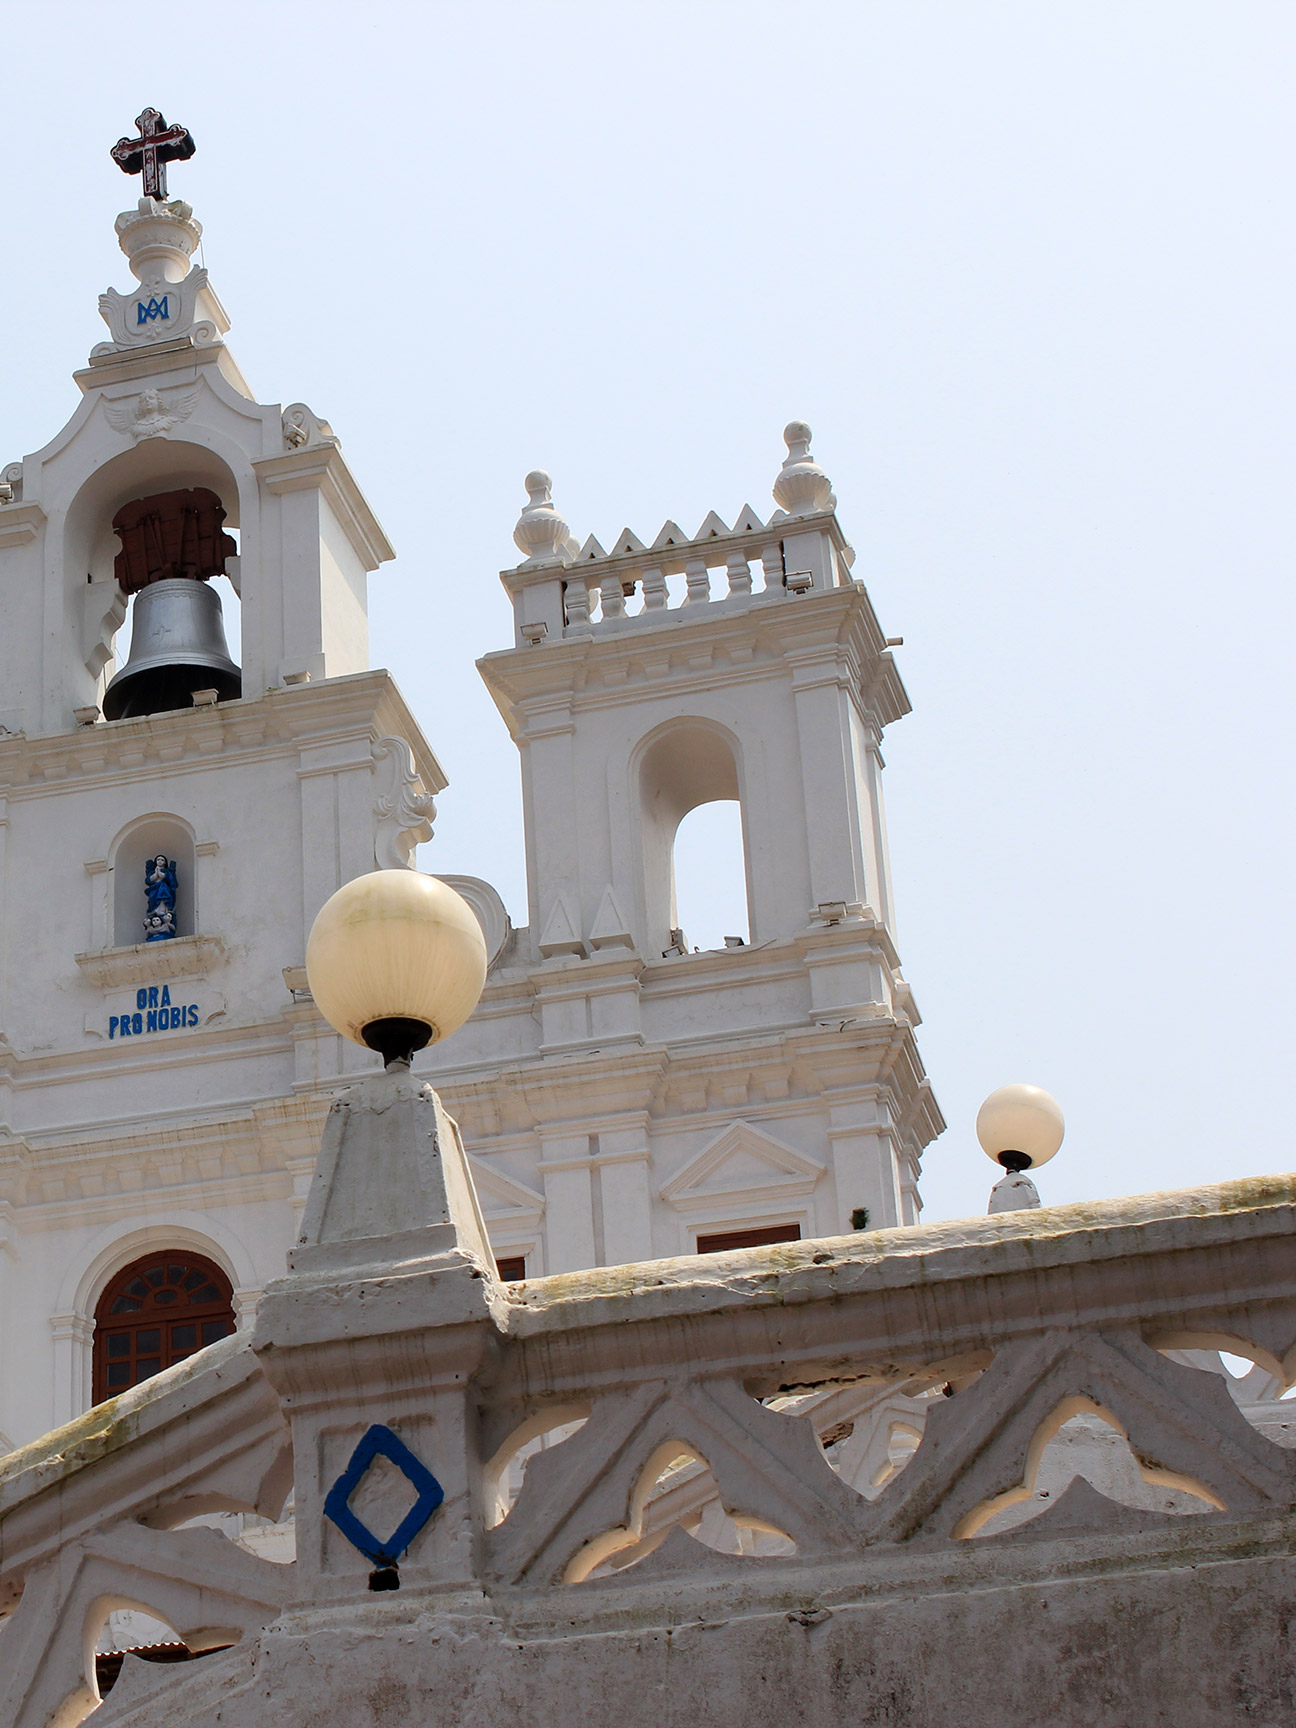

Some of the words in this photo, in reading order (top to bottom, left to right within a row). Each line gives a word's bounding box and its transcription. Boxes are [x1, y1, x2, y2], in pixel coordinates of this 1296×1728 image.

[136, 985, 171, 1009] ORA
[109, 1013, 143, 1039] PRO
[147, 1004, 199, 1032] NOBIS
